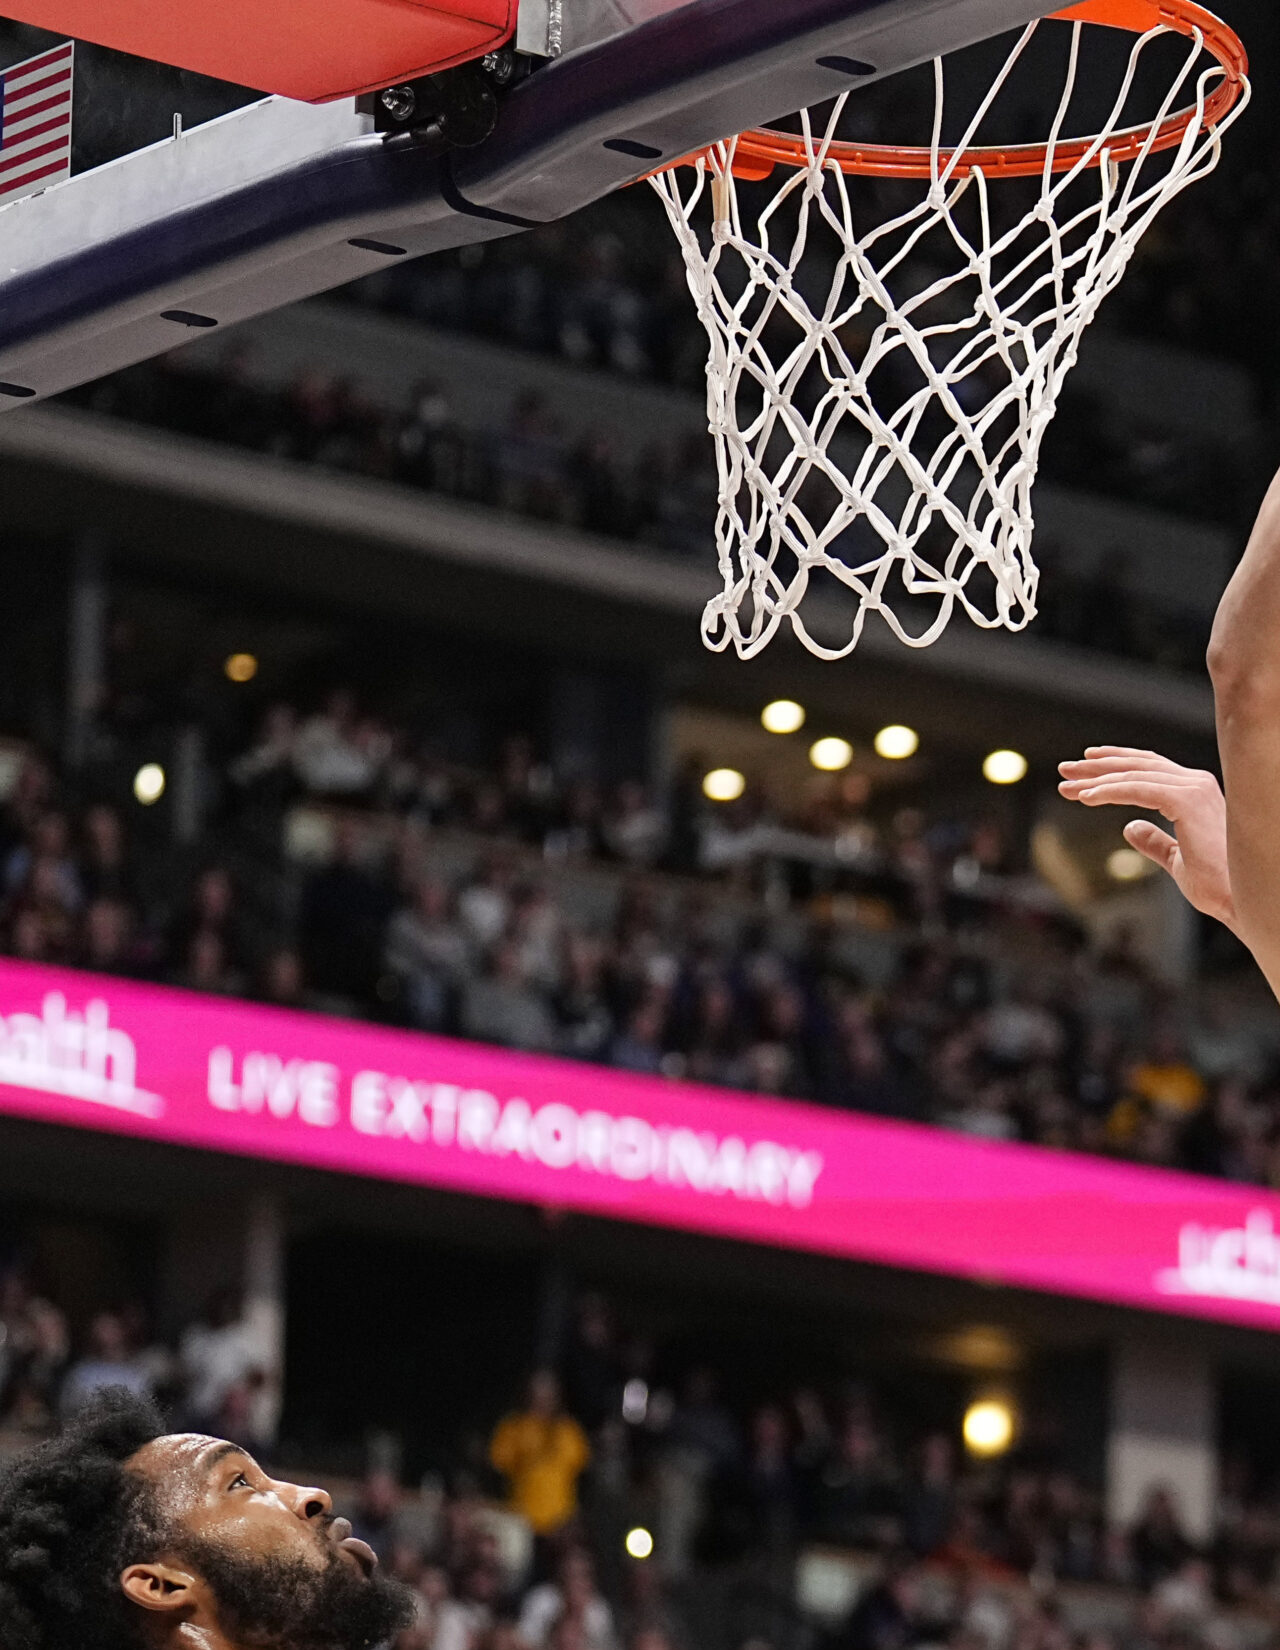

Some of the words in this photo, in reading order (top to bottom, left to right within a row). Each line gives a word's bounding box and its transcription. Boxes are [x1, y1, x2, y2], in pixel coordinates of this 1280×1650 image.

[0, 989, 137, 1096] alth
[207, 1045, 341, 1128] LIVE
[350, 1070, 825, 1210] EXTRAORDINARY
